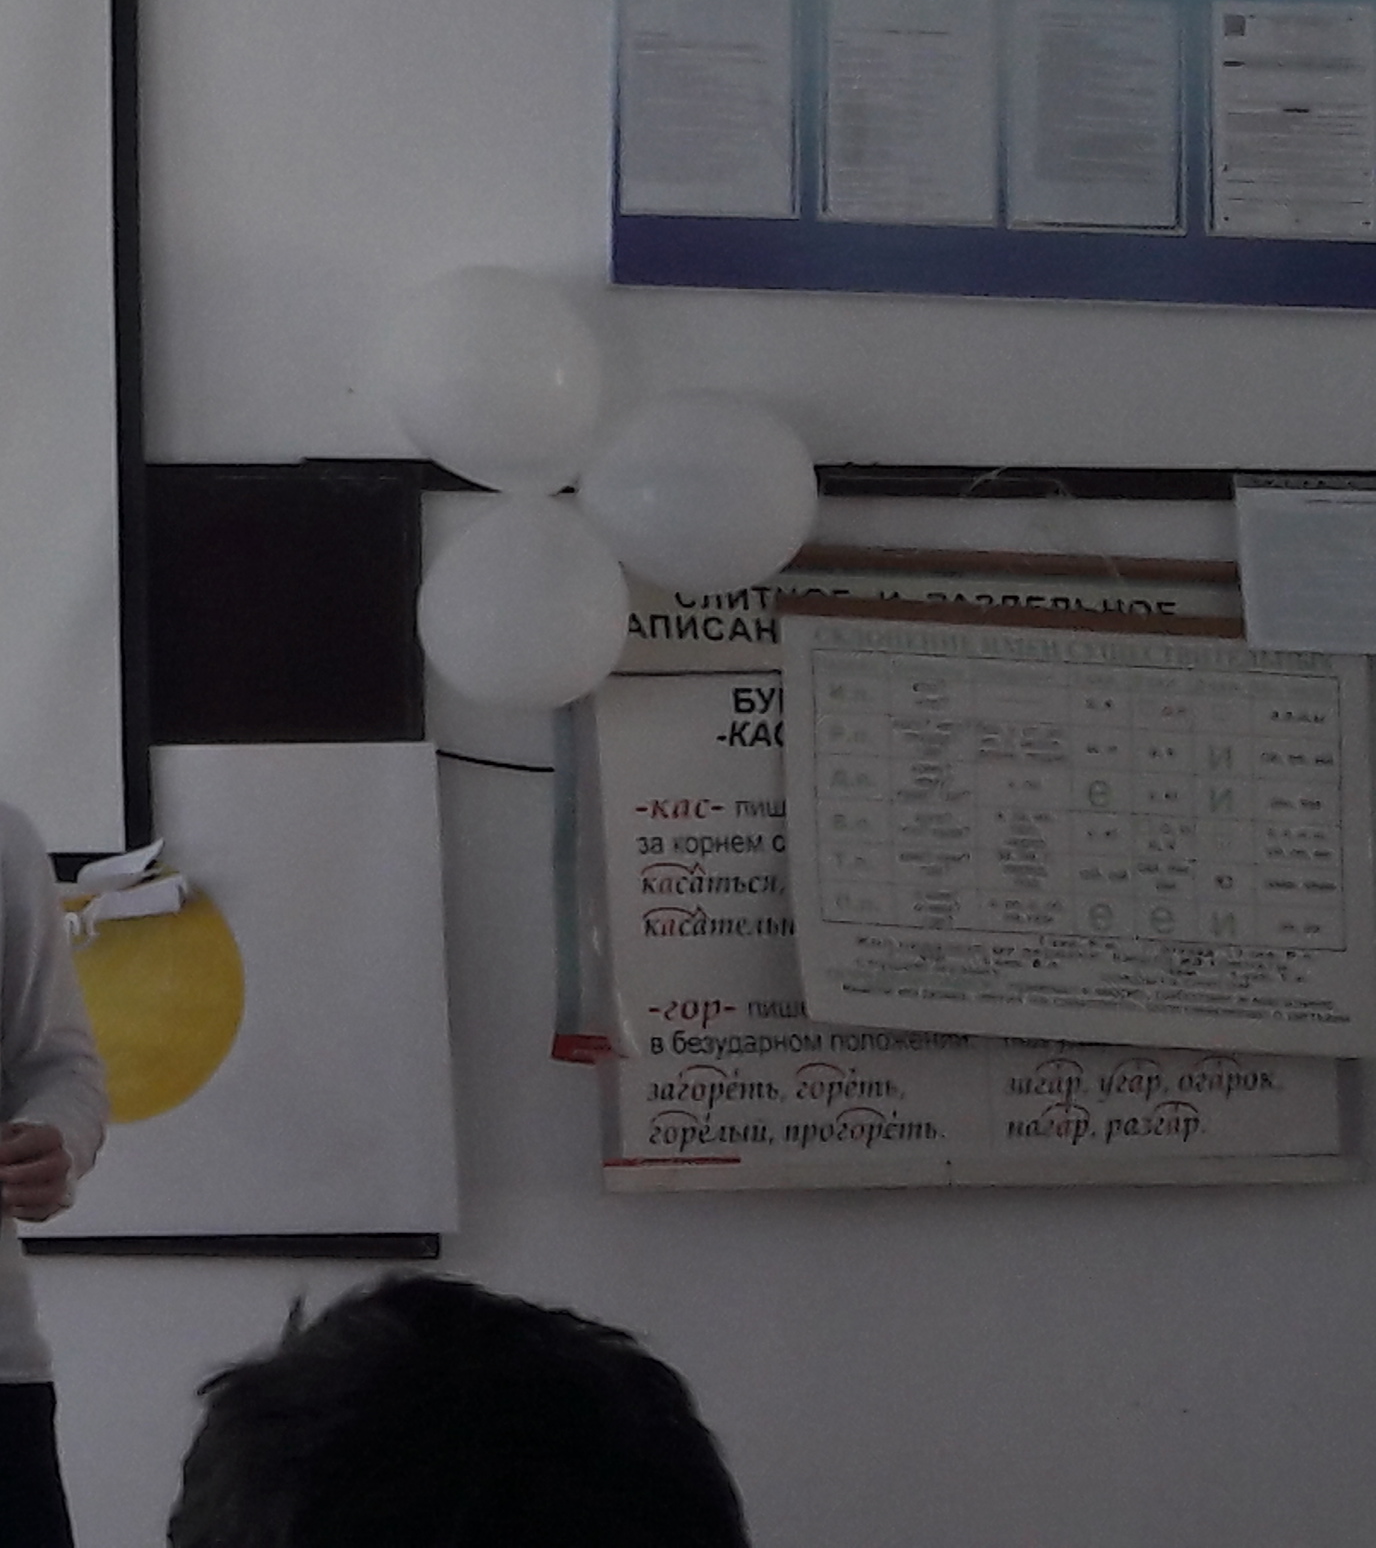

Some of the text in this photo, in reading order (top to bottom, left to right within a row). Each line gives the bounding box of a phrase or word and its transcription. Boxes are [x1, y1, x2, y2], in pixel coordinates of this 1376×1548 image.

[635, 836, 663, 854] за
[674, 834, 765, 856] корнем
[648, 999, 736, 1029] -гор-
[651, 1037, 663, 1054] в
[673, 1030, 821, 1059] безударном
